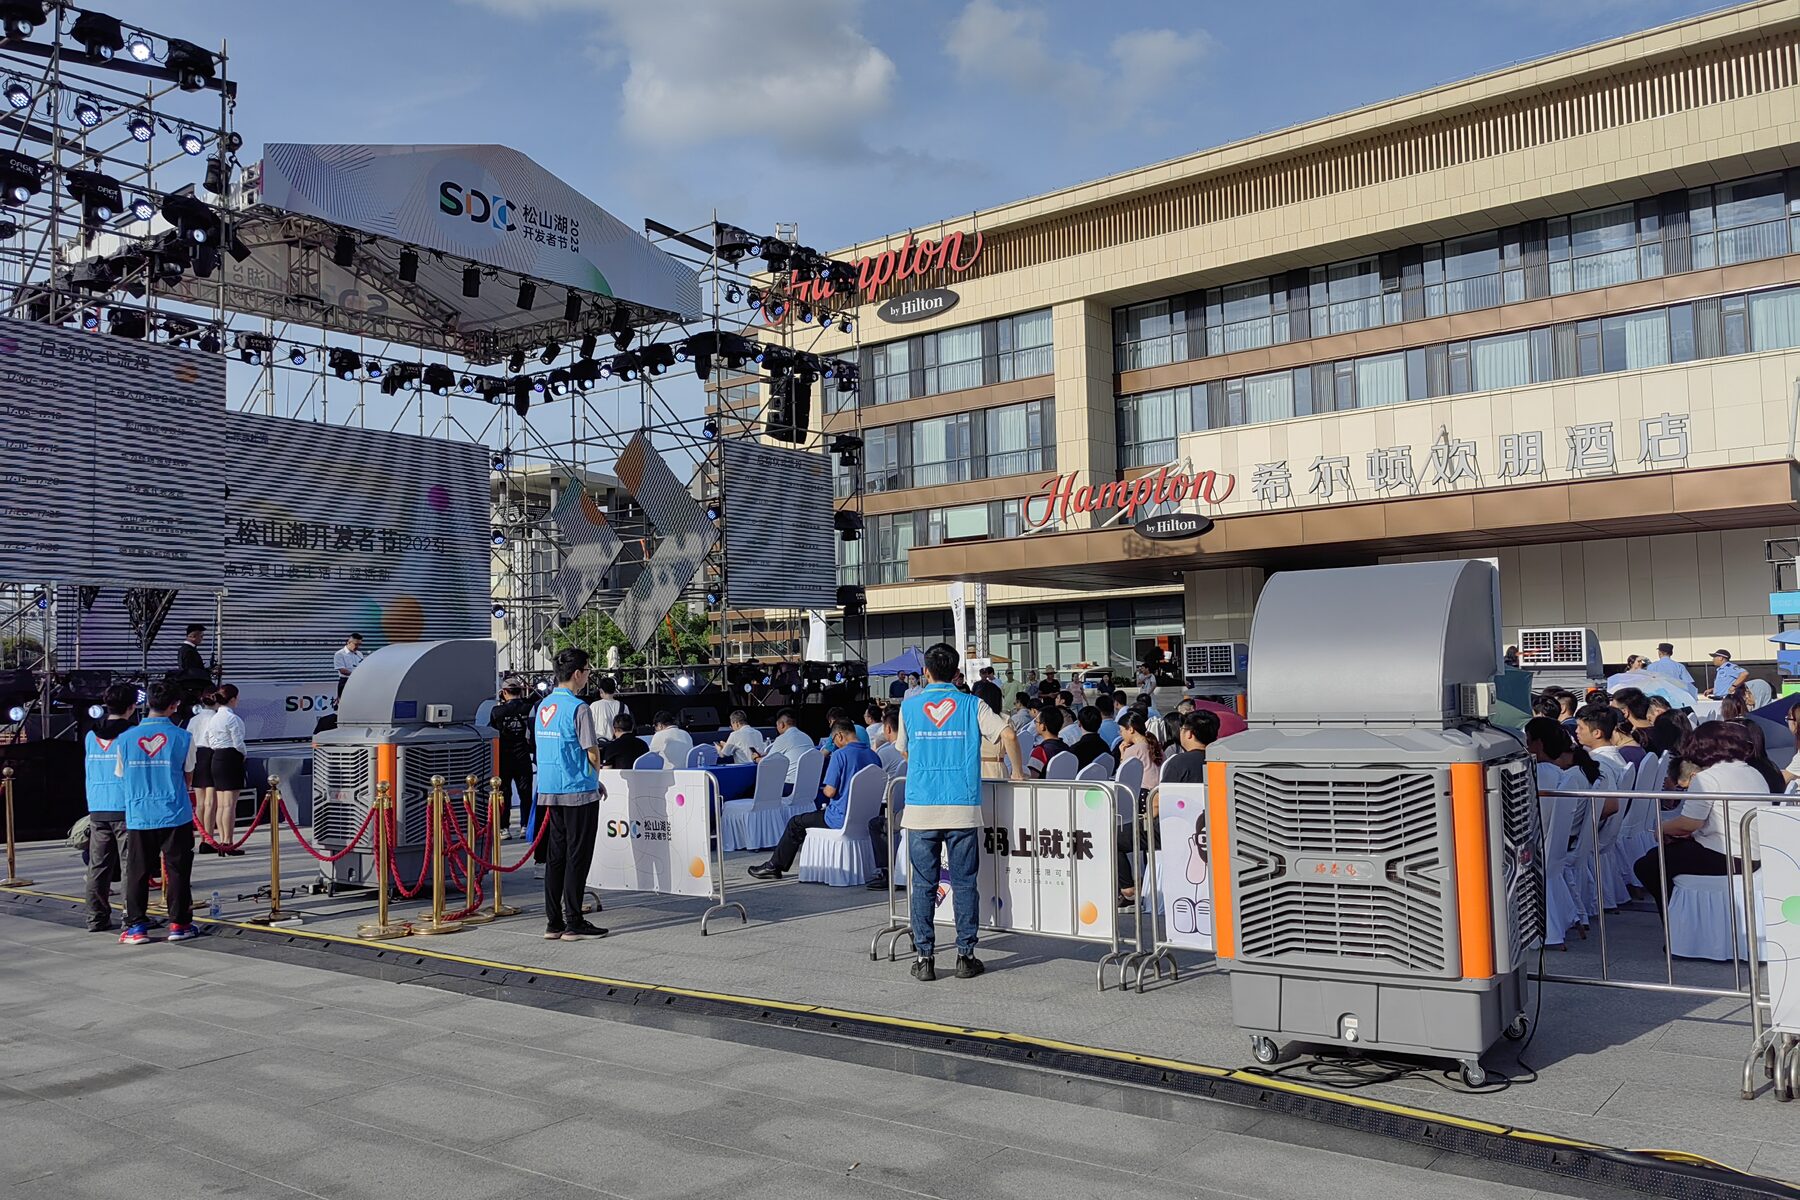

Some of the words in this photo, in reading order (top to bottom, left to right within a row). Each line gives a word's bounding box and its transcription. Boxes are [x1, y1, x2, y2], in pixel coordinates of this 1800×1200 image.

[440, 181, 517, 232] SDC
[522, 204, 568, 235] 松山湖
[522, 225, 568, 250] 开发者节
[570, 218, 579, 254] 2023
[890, 306, 900, 316] by
[901, 296, 943, 316] Hilton
[1250, 412, 1690, 502] 希尔顿欢朋酒店
[1023, 466, 1236, 528] Hampton
[1146, 523, 1156, 533] by
[1156, 518, 1197, 533] Hilton
[285, 695, 328, 711] SDC
[607, 820, 641, 839] SDC
[644, 820, 666, 832] 松山湖
[983, 826, 1094, 860] 码上就来
